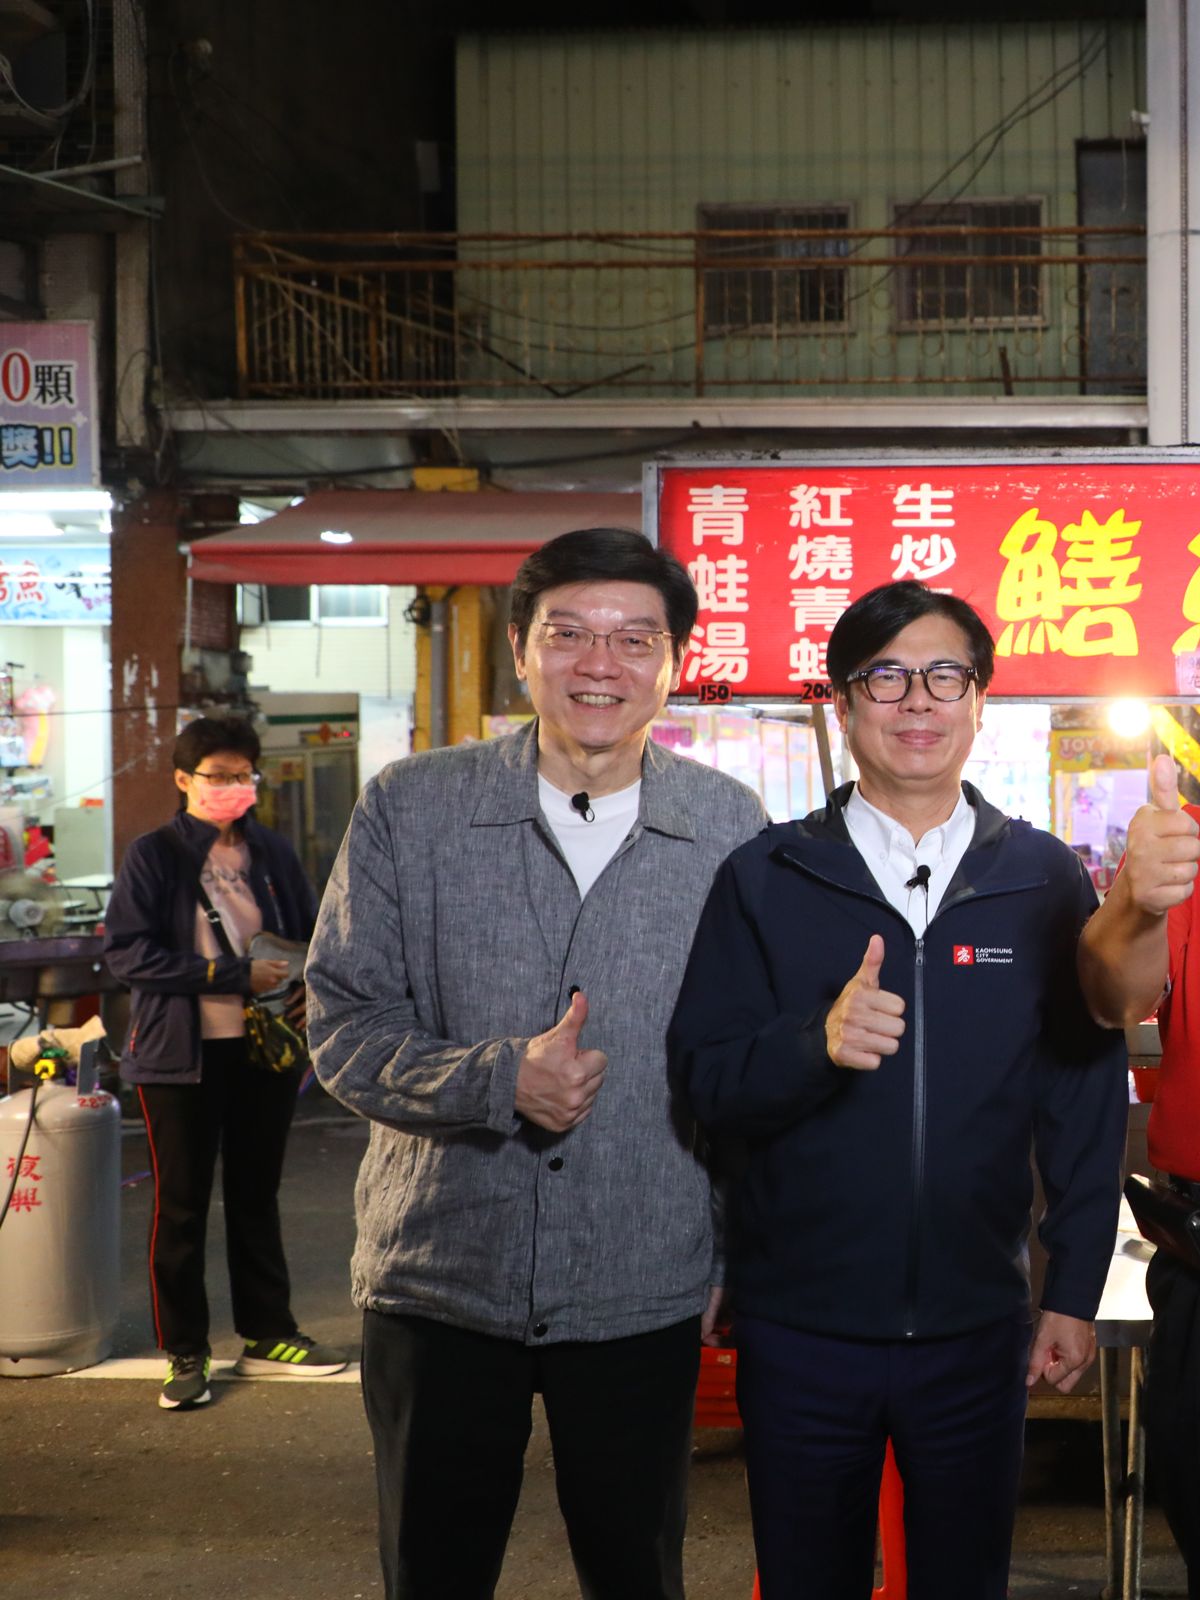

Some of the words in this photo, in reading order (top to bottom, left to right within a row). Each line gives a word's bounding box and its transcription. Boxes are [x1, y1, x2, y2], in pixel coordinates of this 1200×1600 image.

[686, 484, 749, 683] 青蛙湯
[891, 483, 957, 597] 生炒
[700, 684, 729, 701] 150
